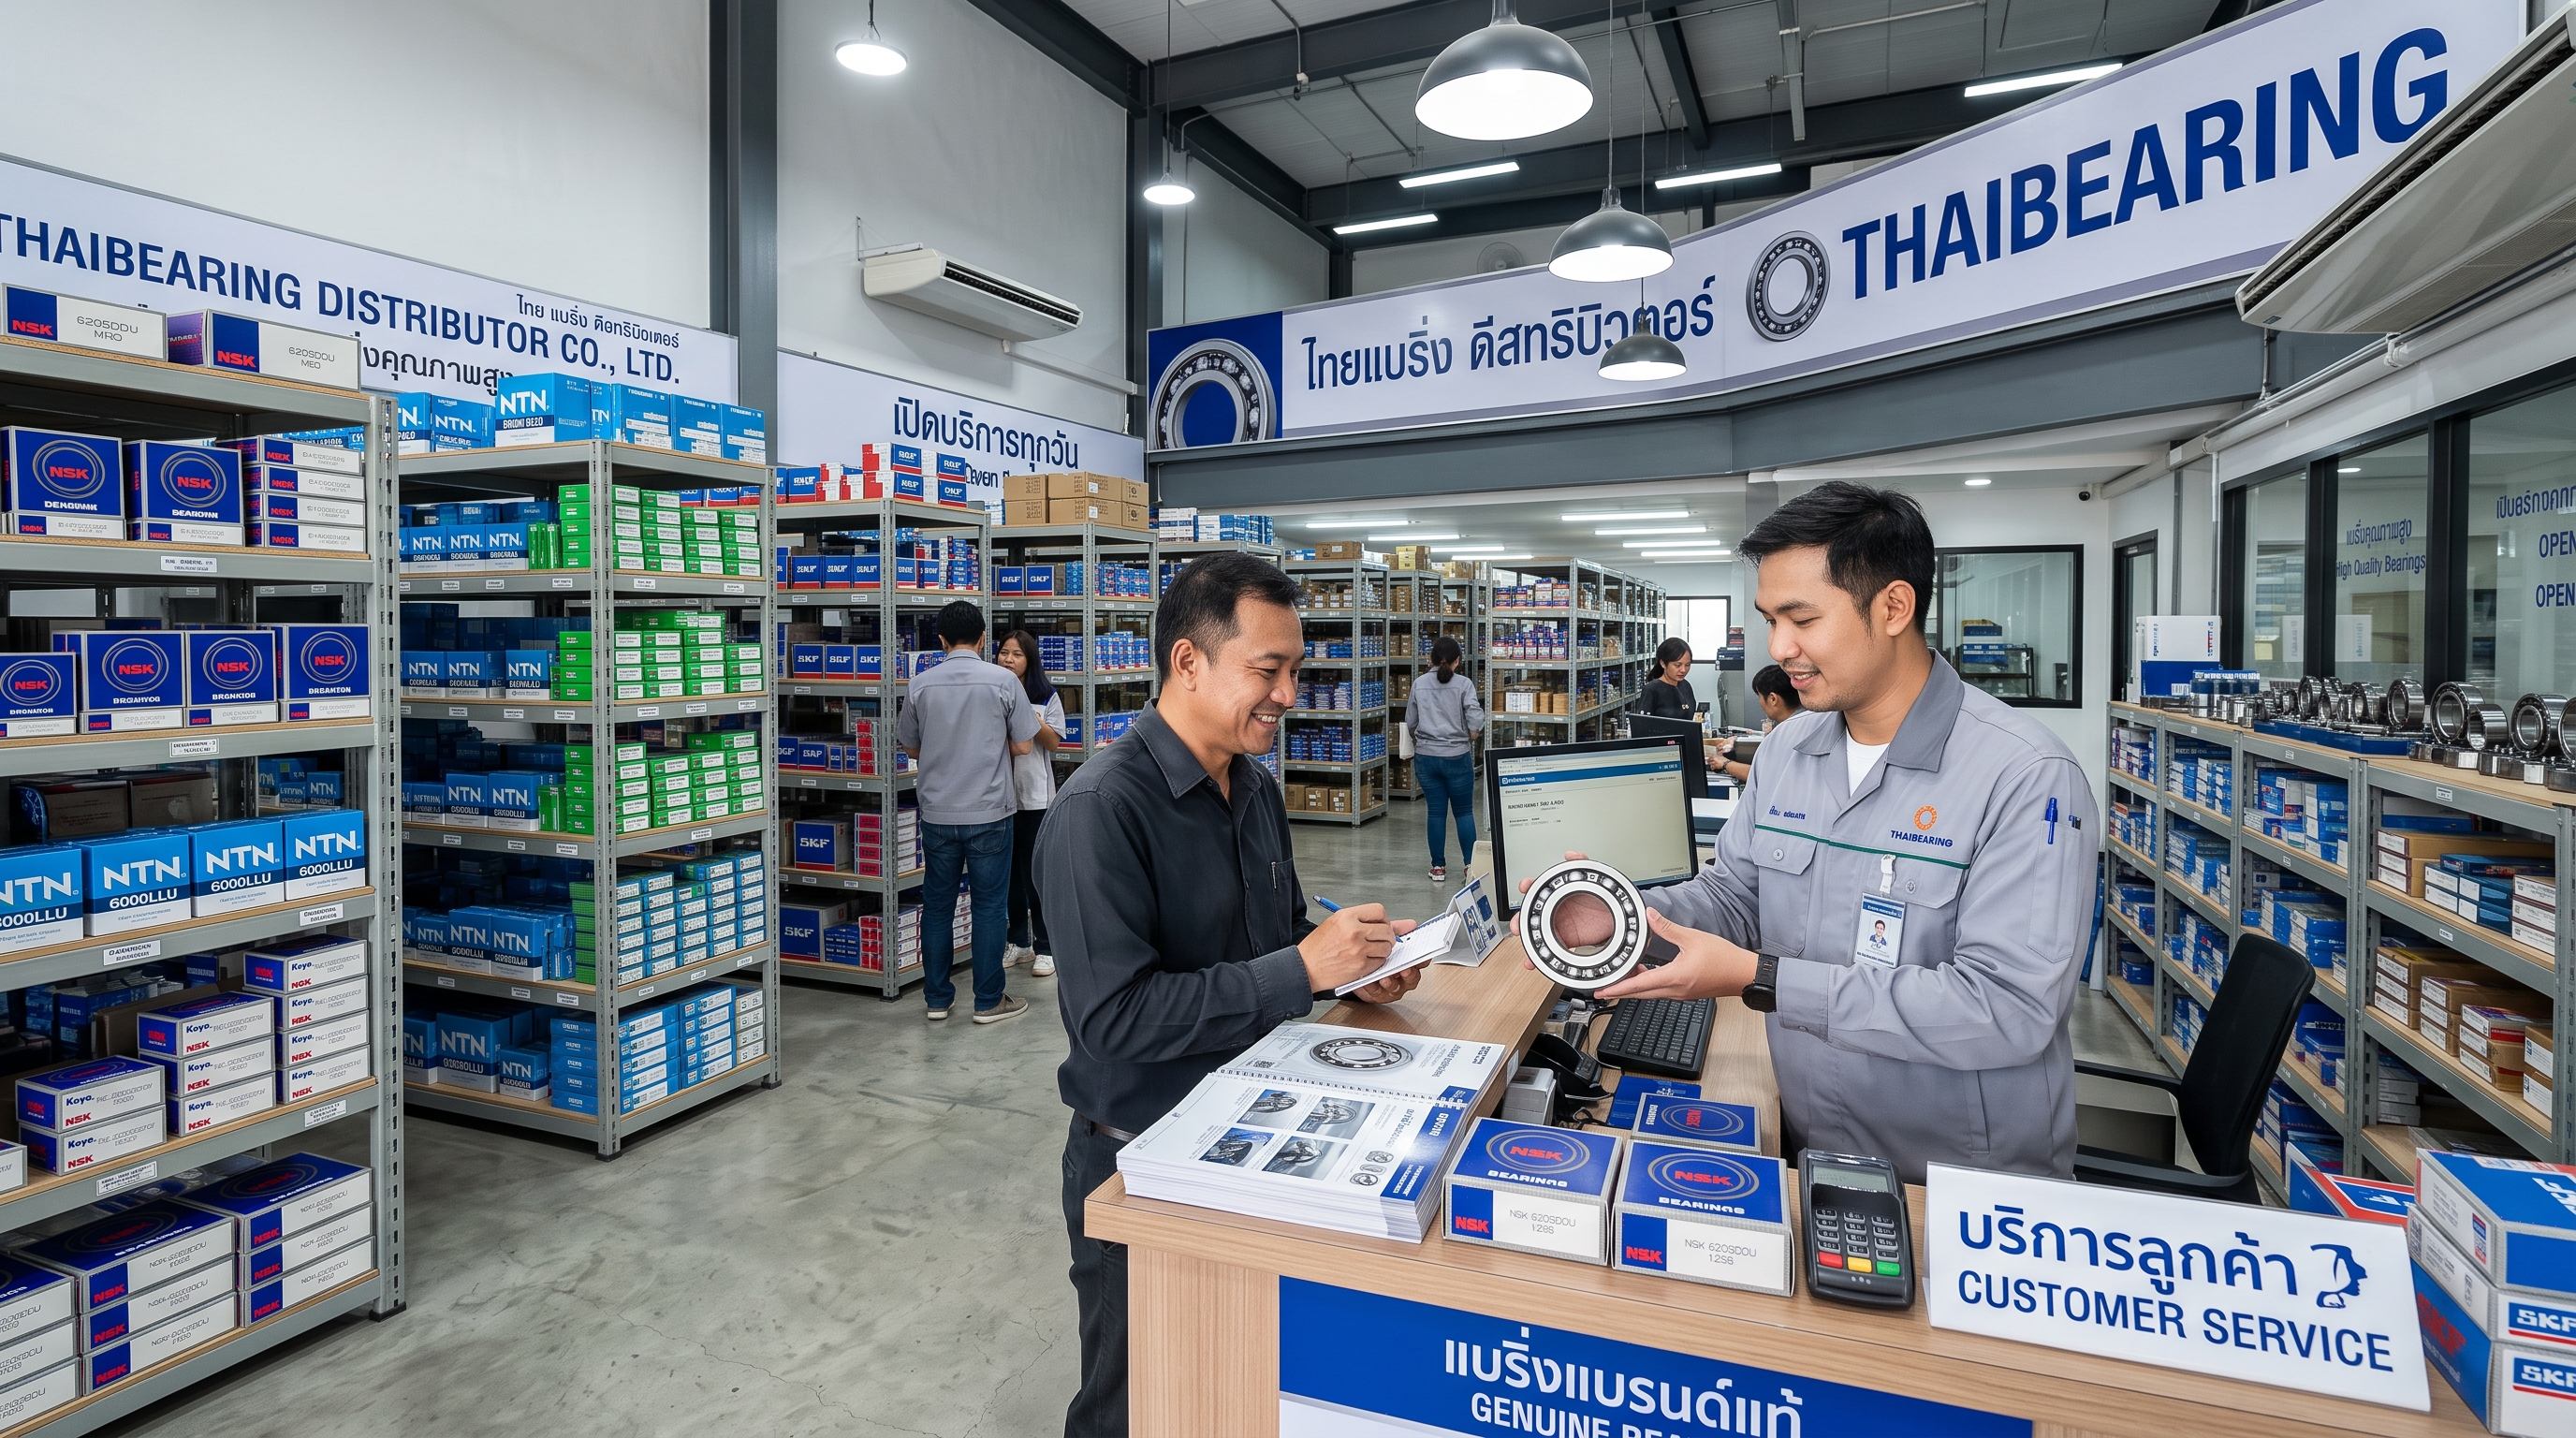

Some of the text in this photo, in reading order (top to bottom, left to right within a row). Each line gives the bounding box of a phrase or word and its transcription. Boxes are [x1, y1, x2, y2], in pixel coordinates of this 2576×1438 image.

[1842, 26, 2449, 300] THAIBEARING
[516, 293, 545, 318] ไทย
[12, 319, 53, 336] NSK
[94, 330, 123, 342] MRO
[318, 280, 549, 360] DISTRIBUTOR
[561, 333, 615, 376] CO.,
[627, 346, 680, 385] LTD.
[217, 349, 256, 368] NSK
[1300, 315, 1454, 390] ไทยแบริ่ง
[500, 389, 547, 416] NTN
[893, 395, 1079, 473] เปิดบริการทุกวัน
[50, 466, 90, 480] NSK
[177, 476, 213, 490] NSK
[2539, 530, 2576, 559] OPEN
[2385, 552, 2426, 574] Bearings
[2535, 582, 2576, 609] OPEN
[119, 664, 155, 675] NSK
[217, 662, 250, 672] NSK
[315, 655, 345, 666] NSK
[408, 662, 438, 676] NTN
[448, 662, 480, 676] NTN
[507, 662, 542, 677] NTN
[14, 680, 49, 691] NSK
[448, 785, 481, 802] NTN
[492, 787, 528, 806] NTN
[295, 829, 357, 859] NTN
[1890, 829, 1954, 848] THAIBEARING
[206, 842, 275, 874] NTN
[299, 858, 354, 877] 6000LLU
[103, 856, 181, 890] NTN
[211, 872, 271, 892] 6000LLU
[109, 888, 178, 909] 6000LLU
[417, 927, 445, 943] NTN
[450, 924, 487, 945] NTN
[493, 931, 530, 953] NTN
[441, 1029, 486, 1059] NTN
[502, 1060, 532, 1078] NTN
[1510, 1145, 1564, 1162] NSK
[1674, 1170, 1734, 1187] NSK
[1509, 1209, 1529, 1220] NSK
[1456, 1215, 1490, 1234] NSK
[1684, 1239, 1705, 1250] NSK
[1958, 1203, 2300, 1297] บริการลูกค้า
[1626, 1245, 1663, 1264] NSK
[1957, 1269, 2394, 1372] CUSTOMER SERVICE
[2516, 1309, 2576, 1333] SKF
[1445, 1326, 1803, 1438] แบริ่งแบรนด์แท้
[2521, 1364, 2576, 1388] SKF
[1471, 1391, 1610, 1438] GENUINE
